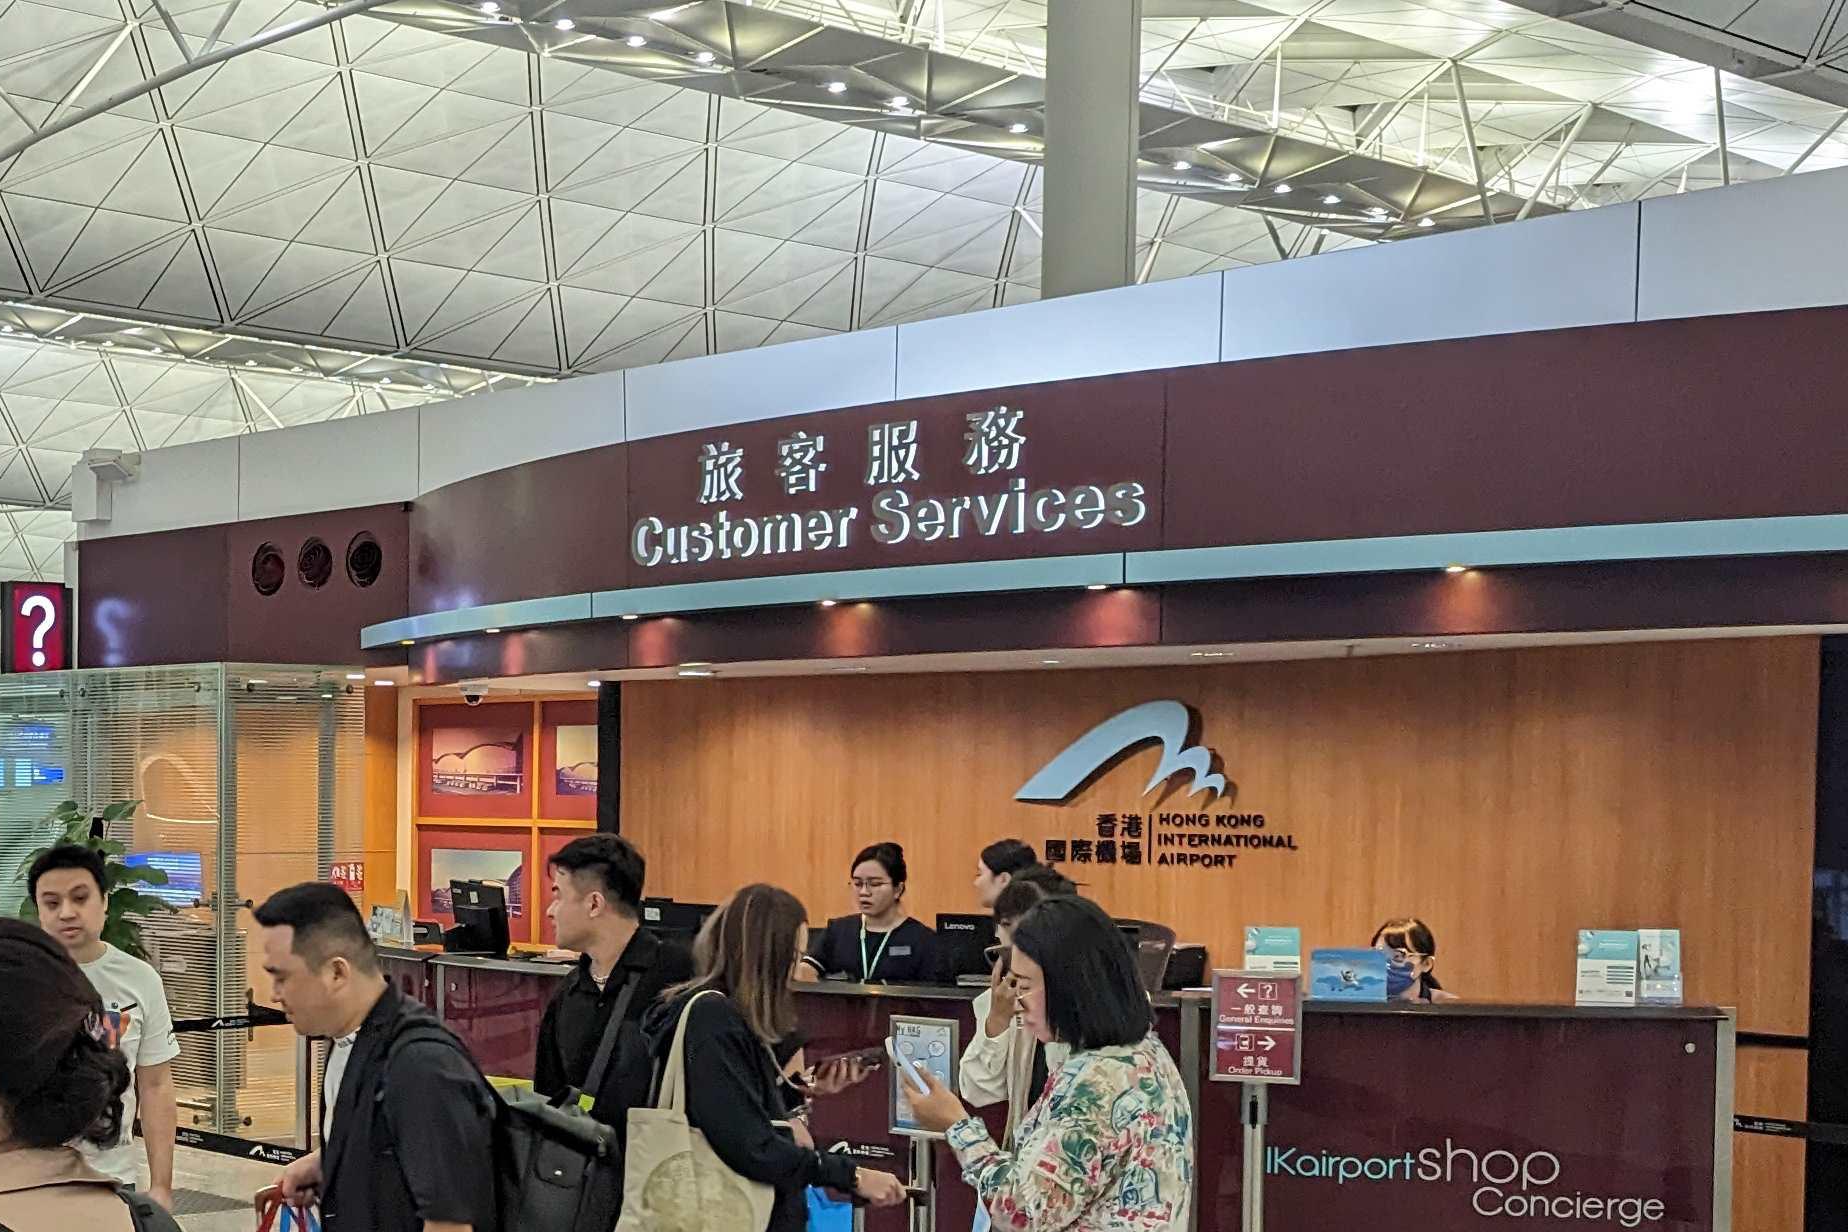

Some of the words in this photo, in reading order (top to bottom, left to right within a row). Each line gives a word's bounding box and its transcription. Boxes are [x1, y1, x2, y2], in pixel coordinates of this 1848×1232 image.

[697, 406, 1027, 505] 旅客服務
[632, 503, 859, 567] Customer
[871, 477, 1147, 544] Services
[1096, 813, 1143, 838] 香港
[1159, 813, 1209, 827] HONG
[1216, 814, 1265, 828] KONG
[1158, 833, 1298, 850] INTERNATIONAL
[1046, 839, 1142, 864] 國際機場
[1158, 853, 1237, 867] AIRPORT
[944, 921, 976, 931] Lenovo
[1219, 1014, 1253, 1023] General
[1228, 1066, 1253, 1075] Order
[1254, 1067, 1283, 1076] Pickup
[1472, 1186, 1665, 1228] Concierge
